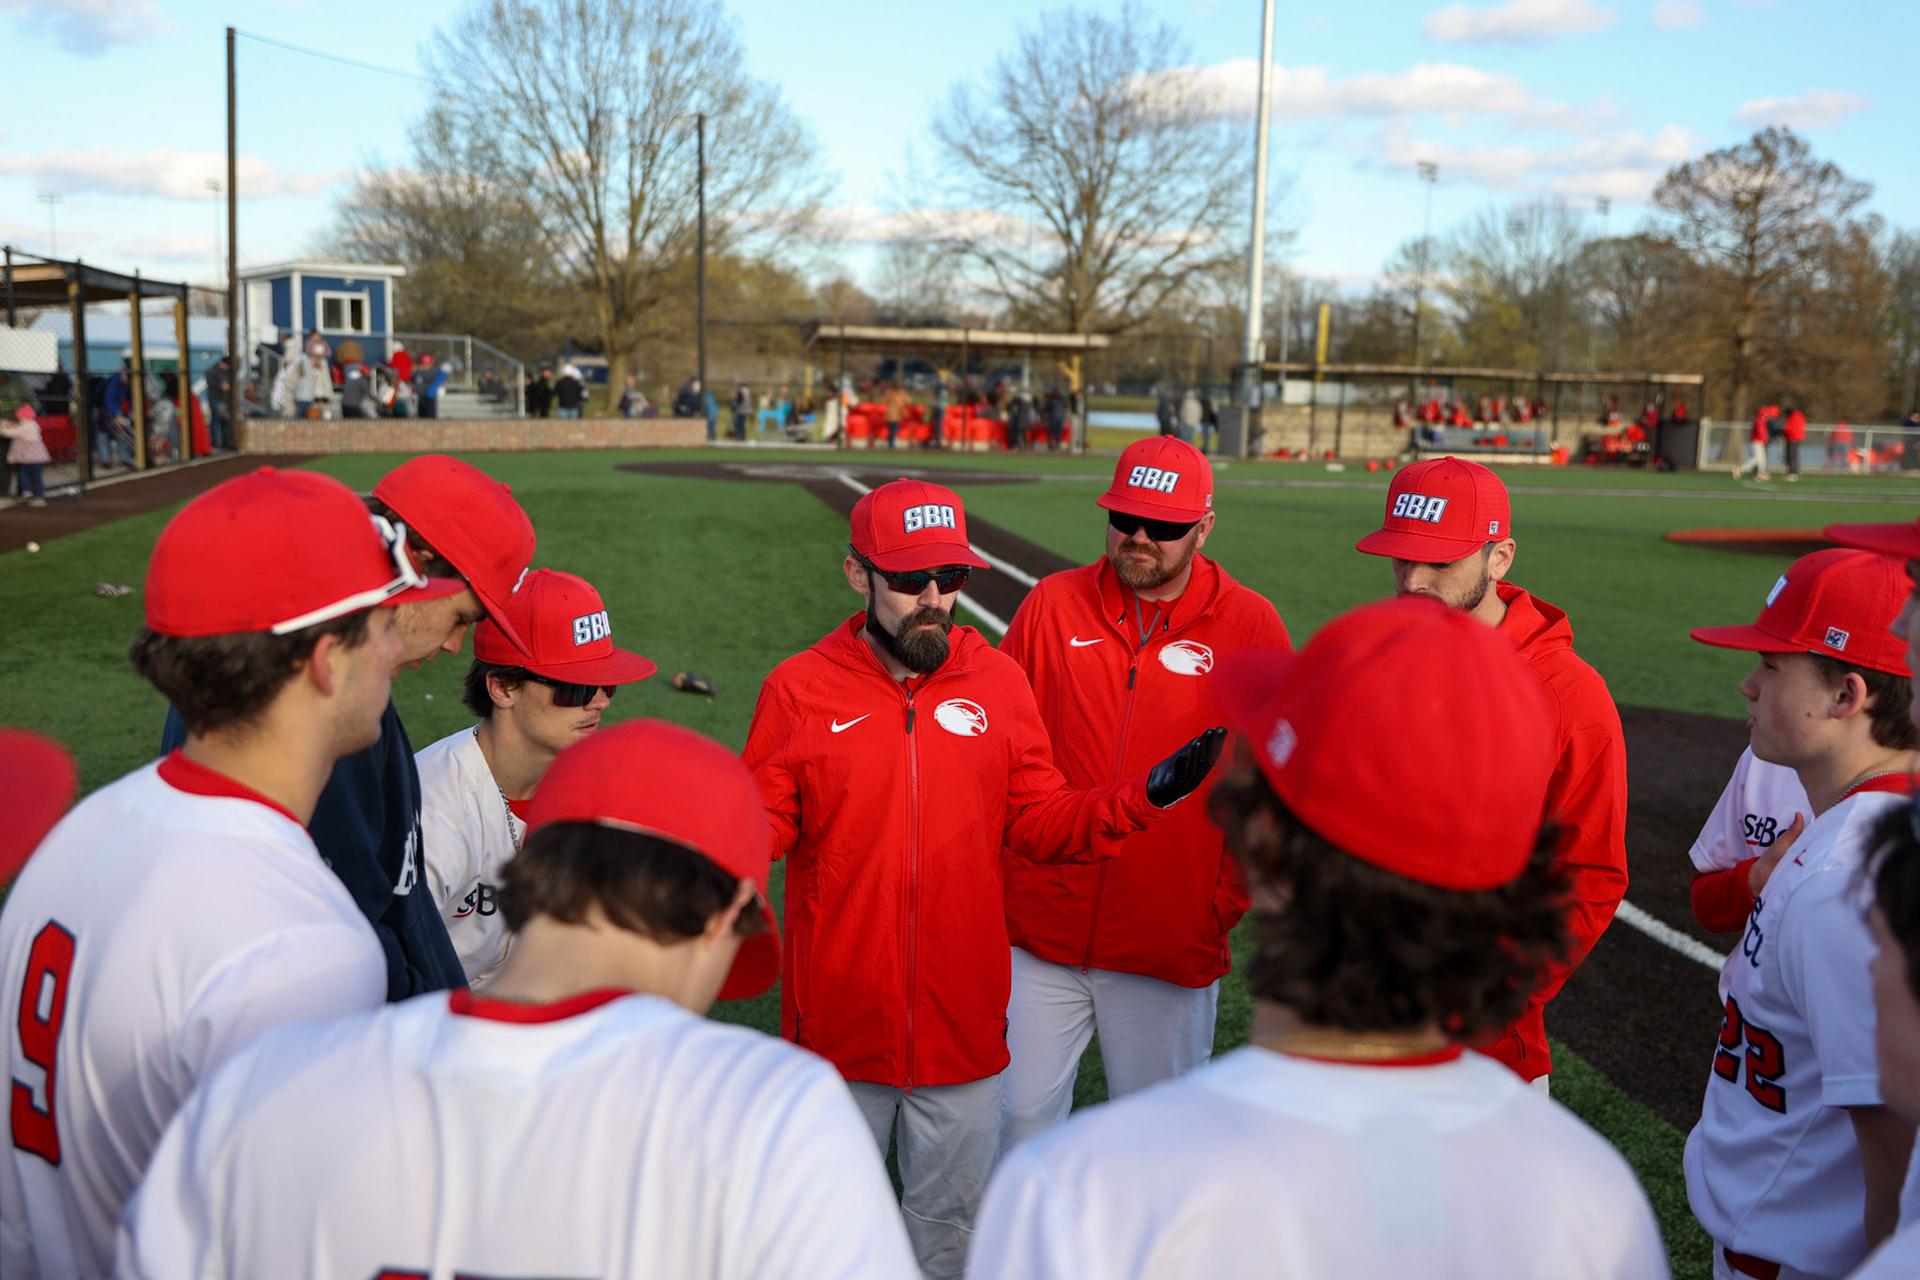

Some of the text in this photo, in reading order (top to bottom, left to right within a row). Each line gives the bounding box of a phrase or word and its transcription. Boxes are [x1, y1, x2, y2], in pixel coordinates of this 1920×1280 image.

[1127, 465, 1180, 494] SBA
[903, 504, 956, 533] SBA
[1392, 493, 1448, 524] SBA
[1744, 813, 1788, 847] StB
[10, 918, 77, 1168] 9
[1714, 991, 1787, 1115] 22
